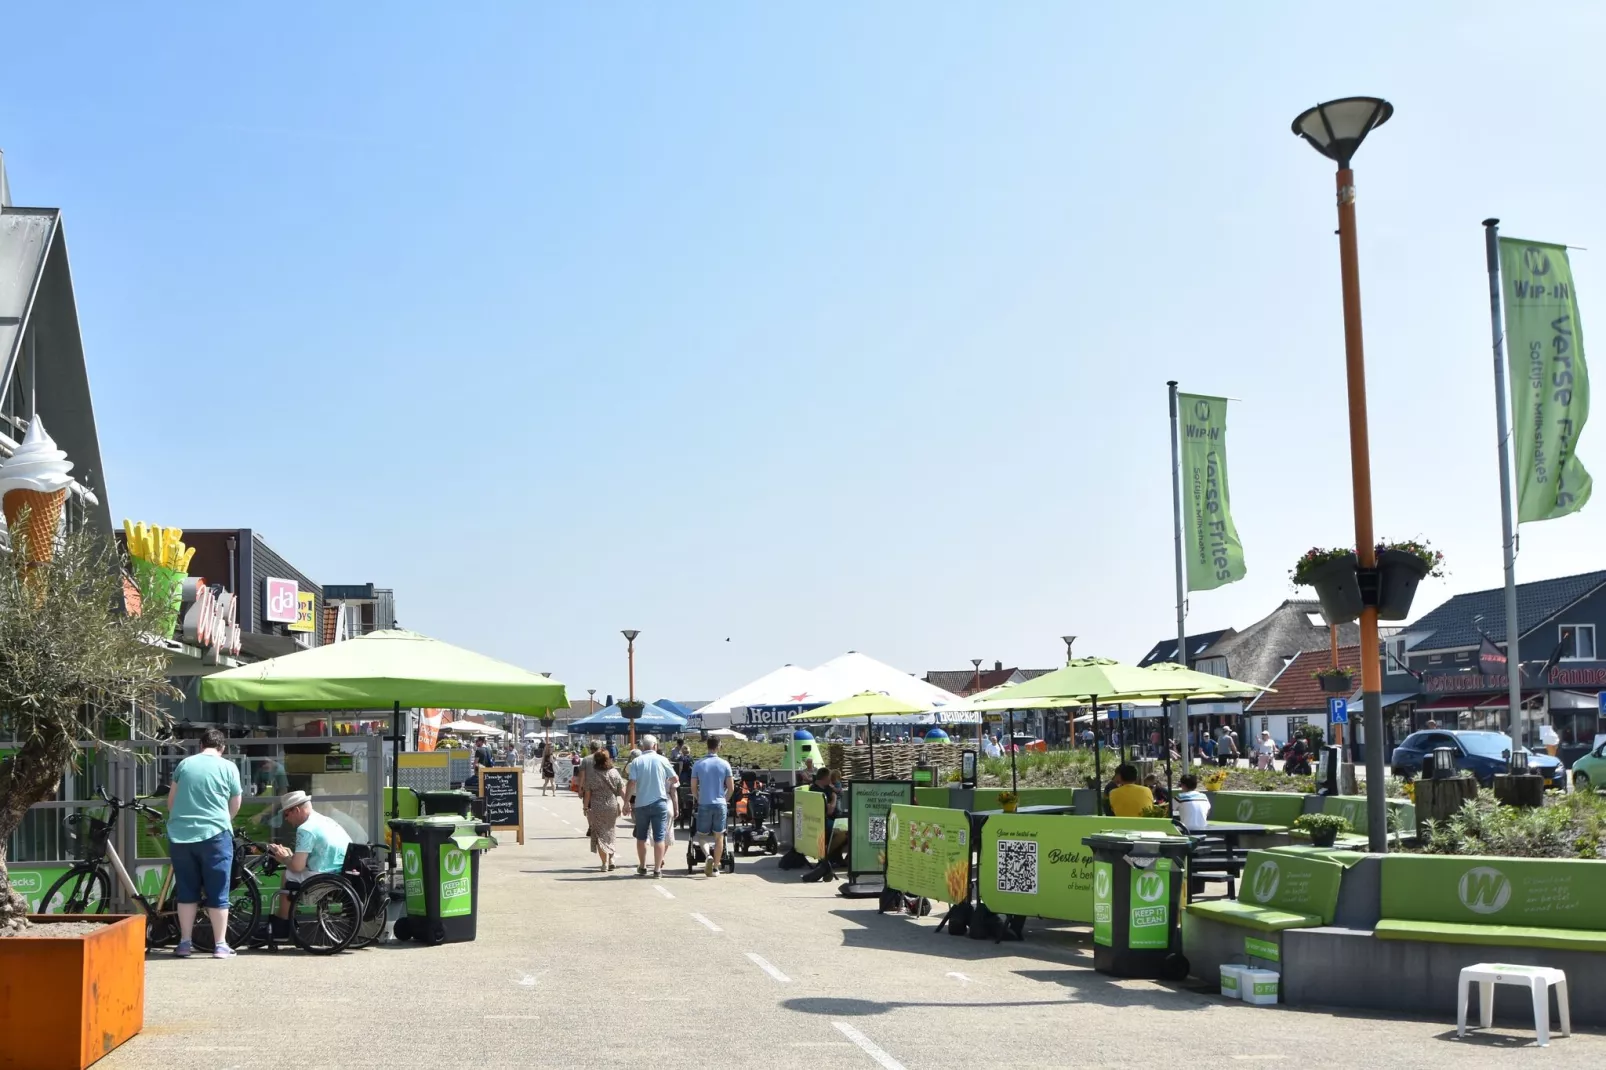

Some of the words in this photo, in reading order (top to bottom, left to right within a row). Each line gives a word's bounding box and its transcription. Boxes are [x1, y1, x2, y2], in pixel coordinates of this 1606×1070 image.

[1529, 341, 1543, 389] Softijs
[1551, 315, 1575, 406] Verse
[1533, 402, 1548, 485] Milkshakes
[1208, 521, 1231, 581] Frites
[1047, 848, 1080, 865] Bestel
[1070, 869, 1078, 878] &
[444, 882, 459, 890] KEEP
[445, 887, 466, 896] CLEAN
[1135, 909, 1155, 918] KEEP
[1156, 907, 1164, 916] IT
[1136, 916, 1162, 925] CLEAN
